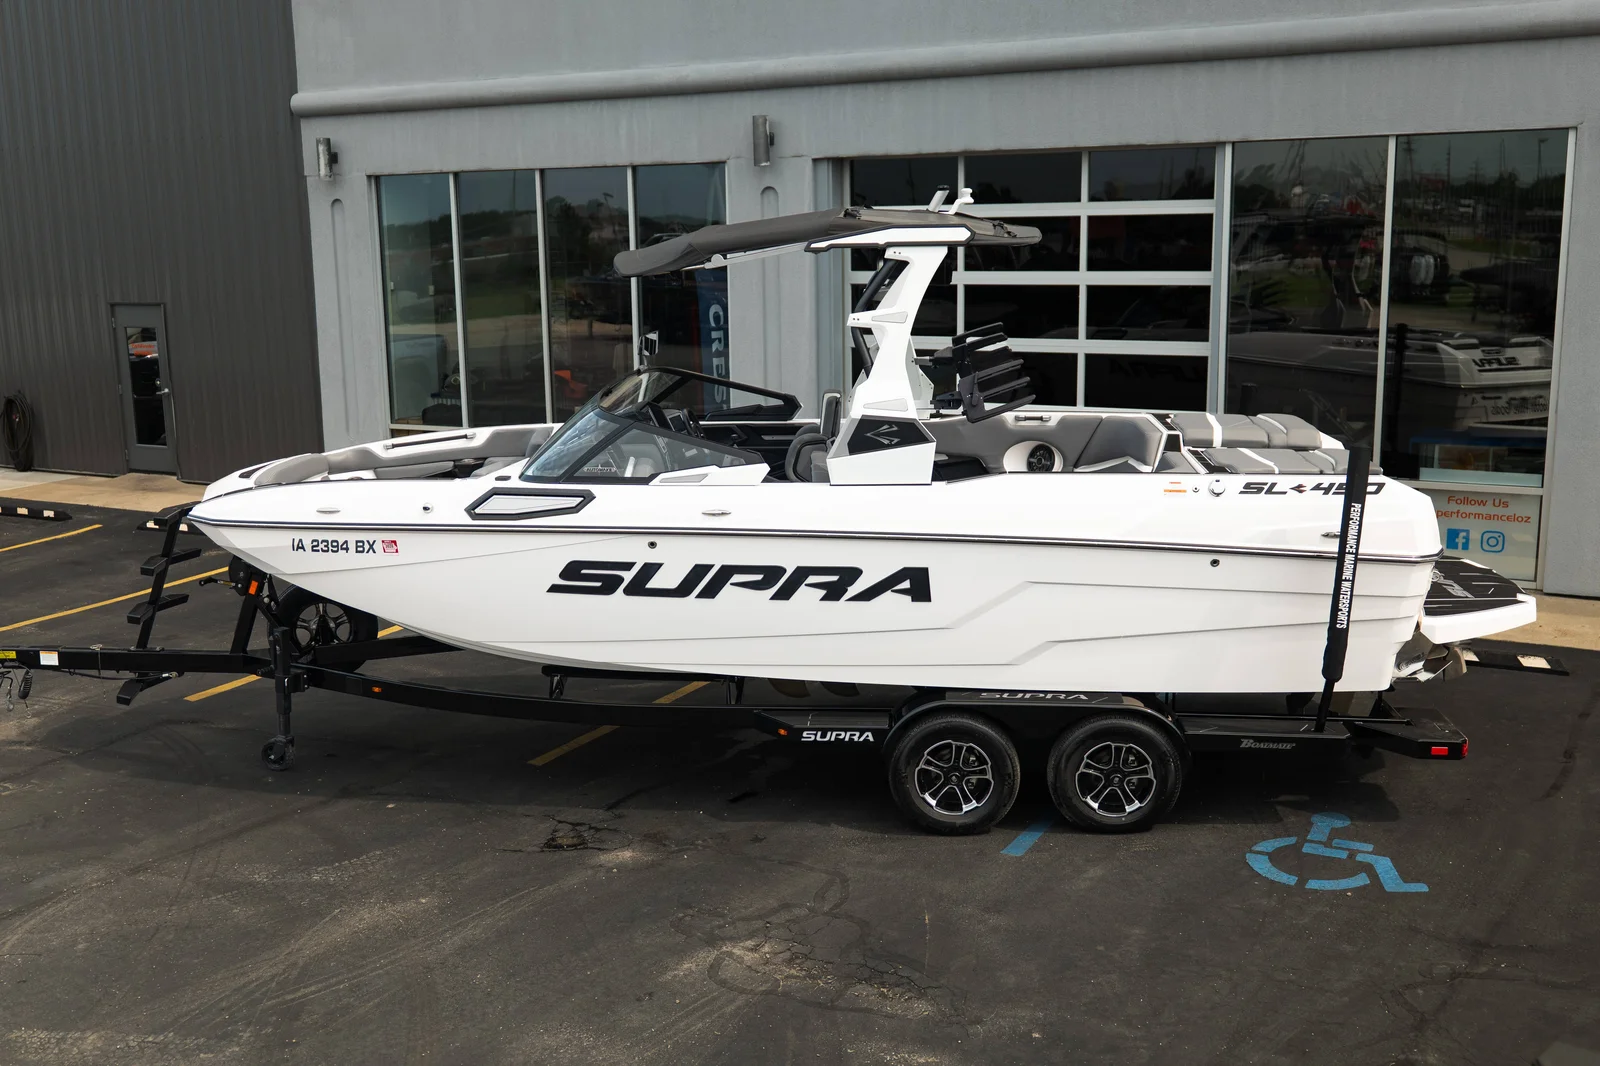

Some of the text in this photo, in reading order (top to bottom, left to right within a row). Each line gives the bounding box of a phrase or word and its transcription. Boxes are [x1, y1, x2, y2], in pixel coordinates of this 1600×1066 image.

[708, 304, 727, 410] CRES
[1238, 482, 1288, 495] SL
[1447, 495, 1509, 509] Follow Us
[292, 538, 306, 552] IA
[311, 539, 350, 553] 2394
[355, 540, 377, 554] BX
[1336, 502, 1362, 629] PERFORMANCE MARINE WATERSPORTS
[546, 559, 932, 603] SUPRA
[980, 692, 1090, 701] SUPRA
[801, 730, 876, 743] SUPRA
